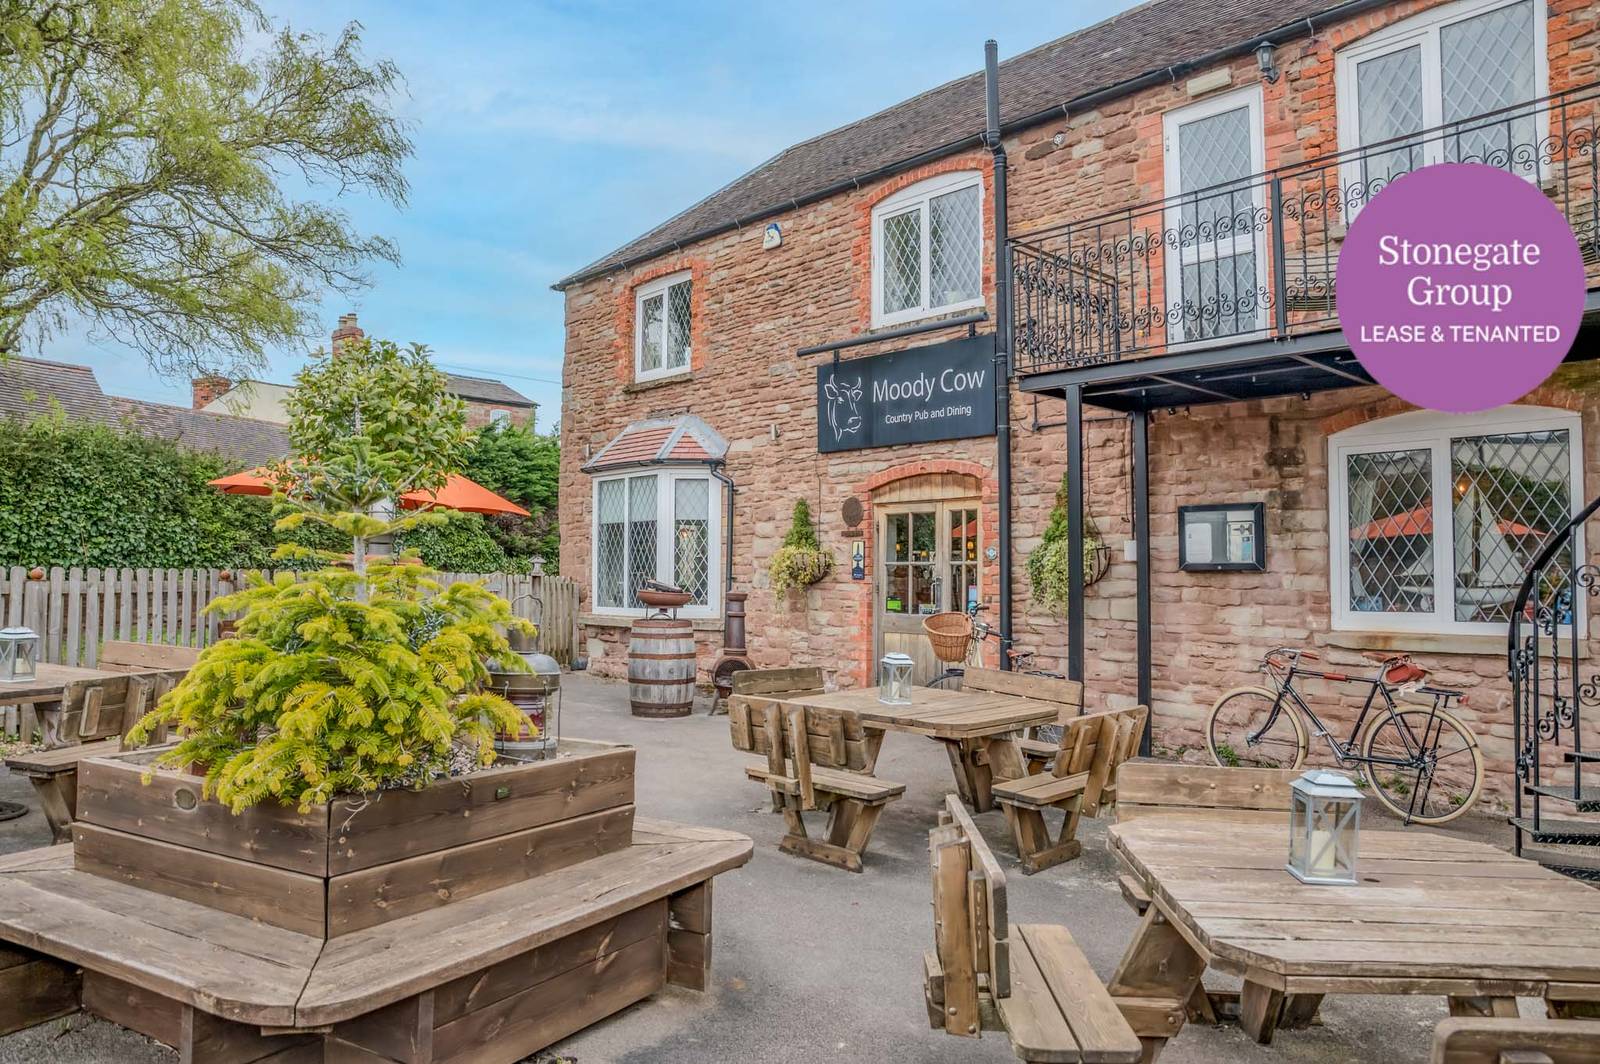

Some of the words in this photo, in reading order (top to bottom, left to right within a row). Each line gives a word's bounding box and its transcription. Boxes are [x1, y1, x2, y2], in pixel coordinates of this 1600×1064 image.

[873, 372, 936, 403] Moody
[940, 368, 985, 393] Cow
[885, 412, 913, 425] Country
[914, 409, 929, 421] Pub
[930, 407, 945, 419] and
[946, 404, 972, 417] Dining
